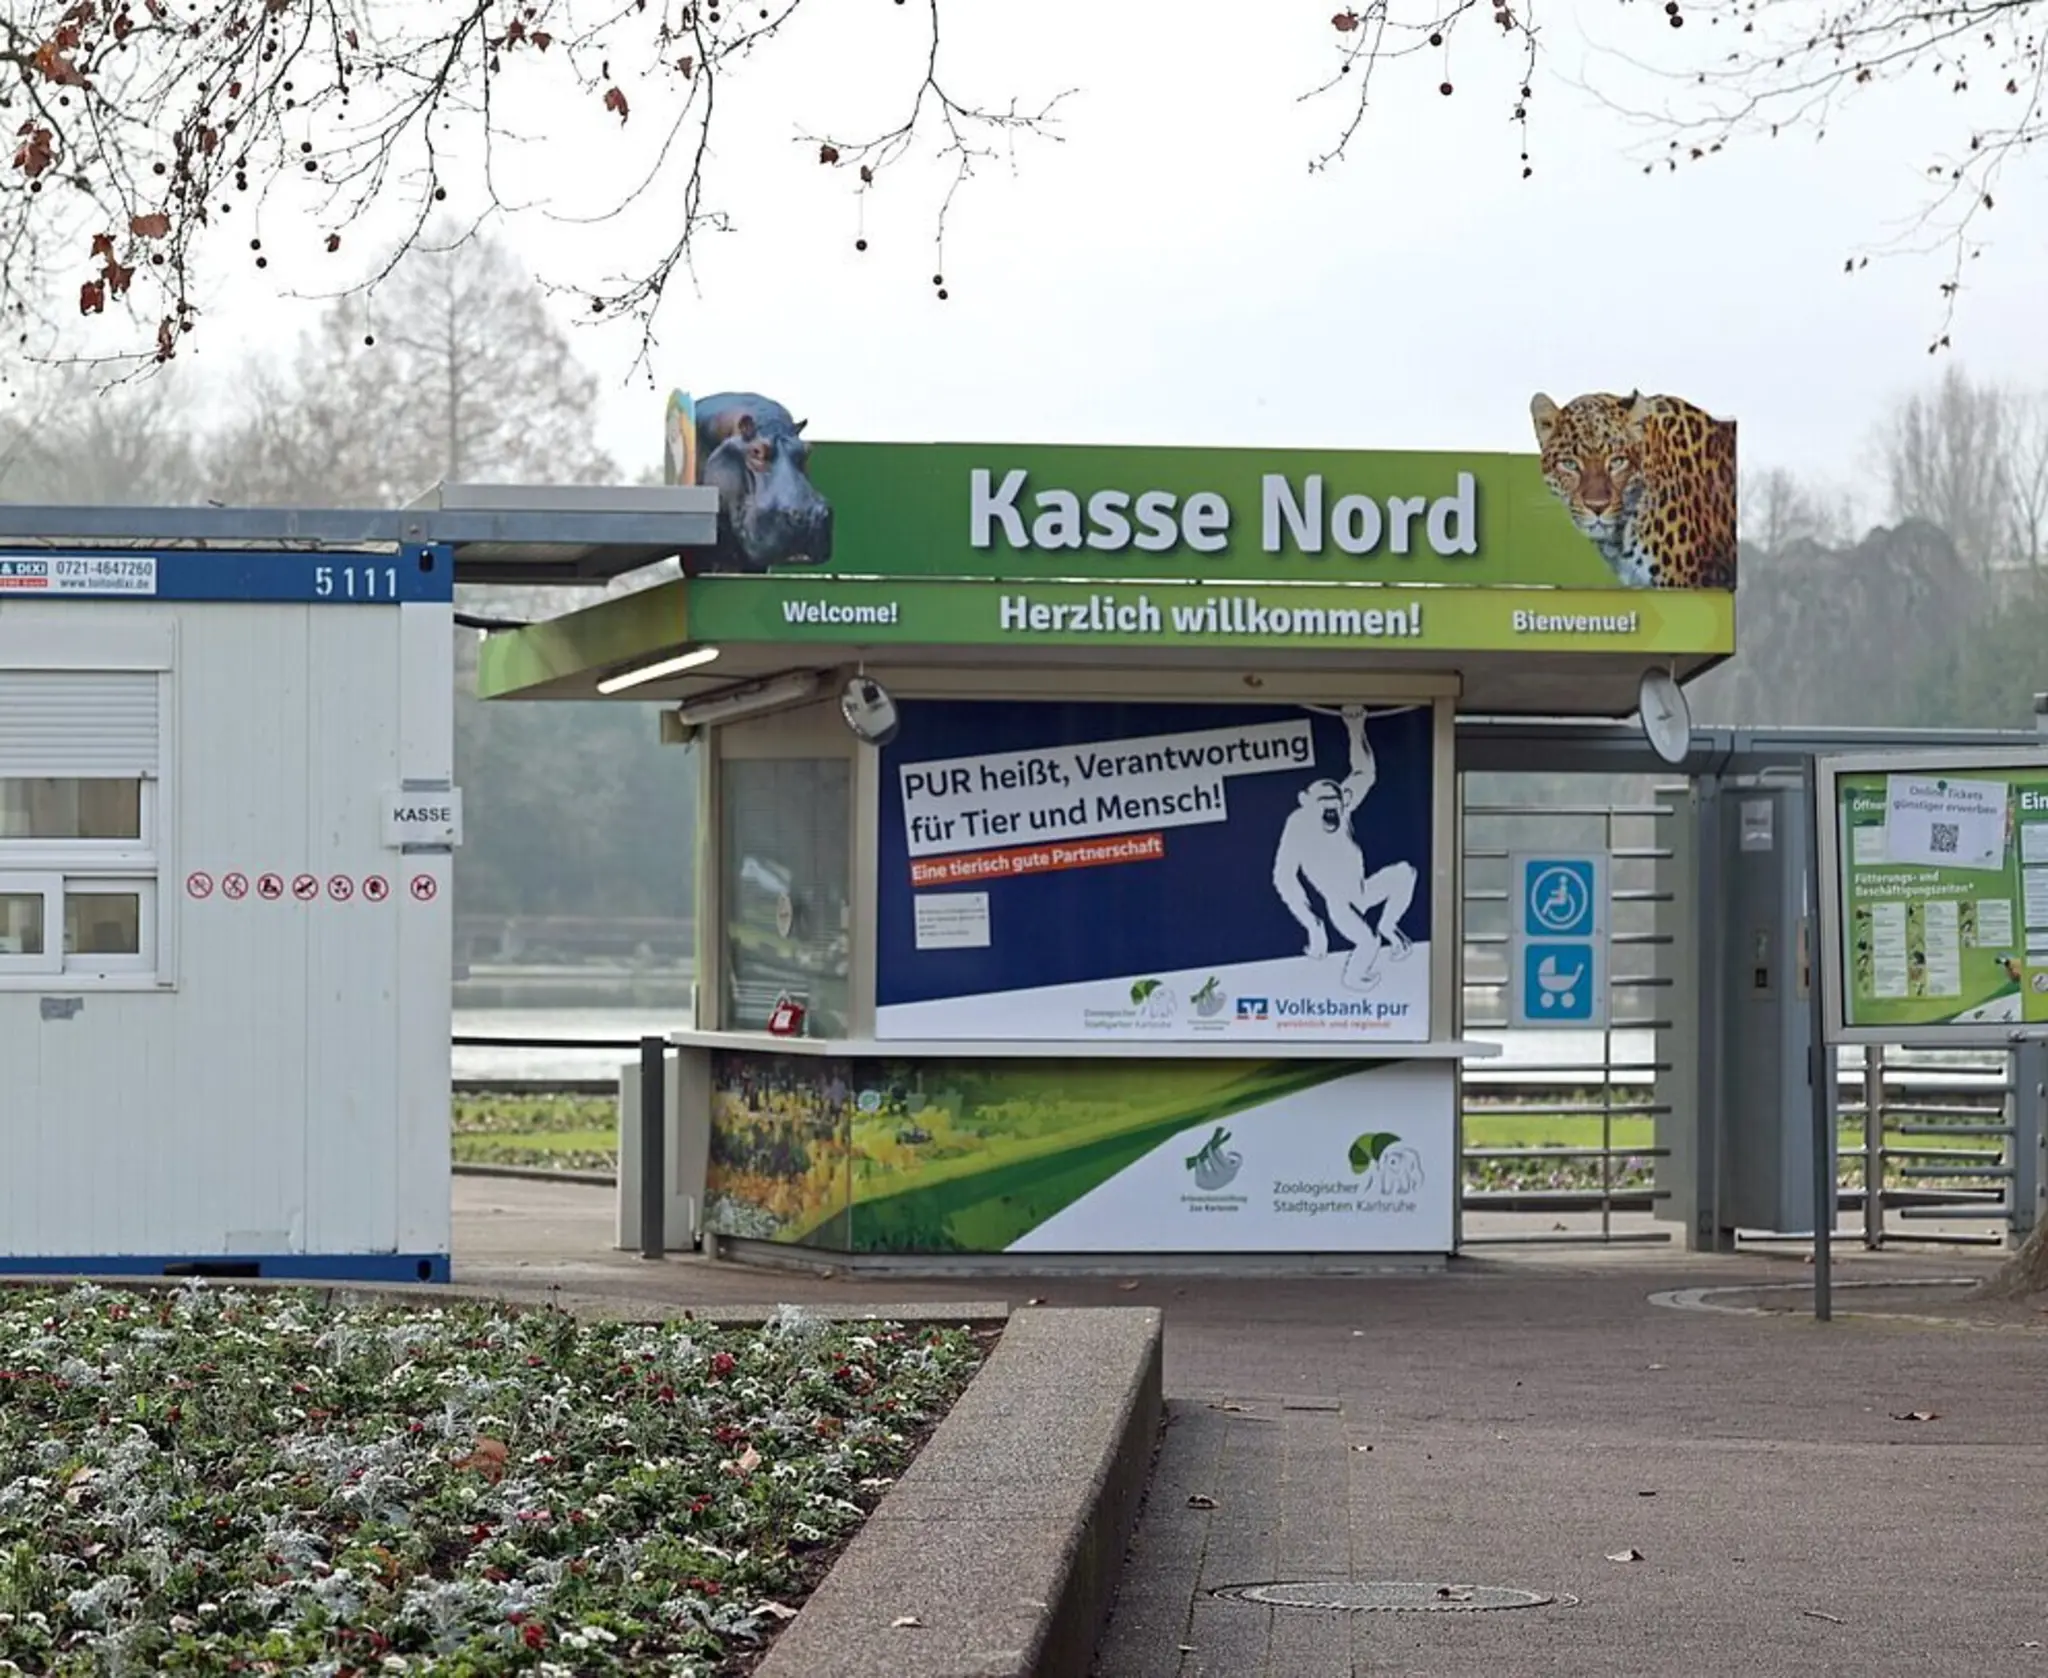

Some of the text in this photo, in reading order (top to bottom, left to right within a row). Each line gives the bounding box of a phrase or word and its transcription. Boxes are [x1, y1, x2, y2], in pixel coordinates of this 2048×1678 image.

[969, 468, 1478, 556] Kasse Nord
[16, 562, 46, 574] DIXI
[56, 561, 153, 575] 0721-4647260
[315, 567, 397, 597] 5111
[782, 600, 898, 624] Welcome!
[1000, 594, 1422, 636] Herzlich willkommen!
[1512, 609, 1638, 633] Bienvenue!
[905, 735, 1309, 800] PUR heißt, Verantwortung
[1948, 787, 1983, 802] Tickets
[393, 807, 452, 822] KASSE
[911, 783, 1222, 843] für Tier und Mensch!
[911, 838, 1163, 881] Eine tierisch gute Partnerschaft
[1275, 998, 1410, 1020] Volksbank pur
[1273, 1180, 1359, 1198] Zoologischer
[1273, 1199, 1418, 1217] Stadtgarten Karlsruhe
